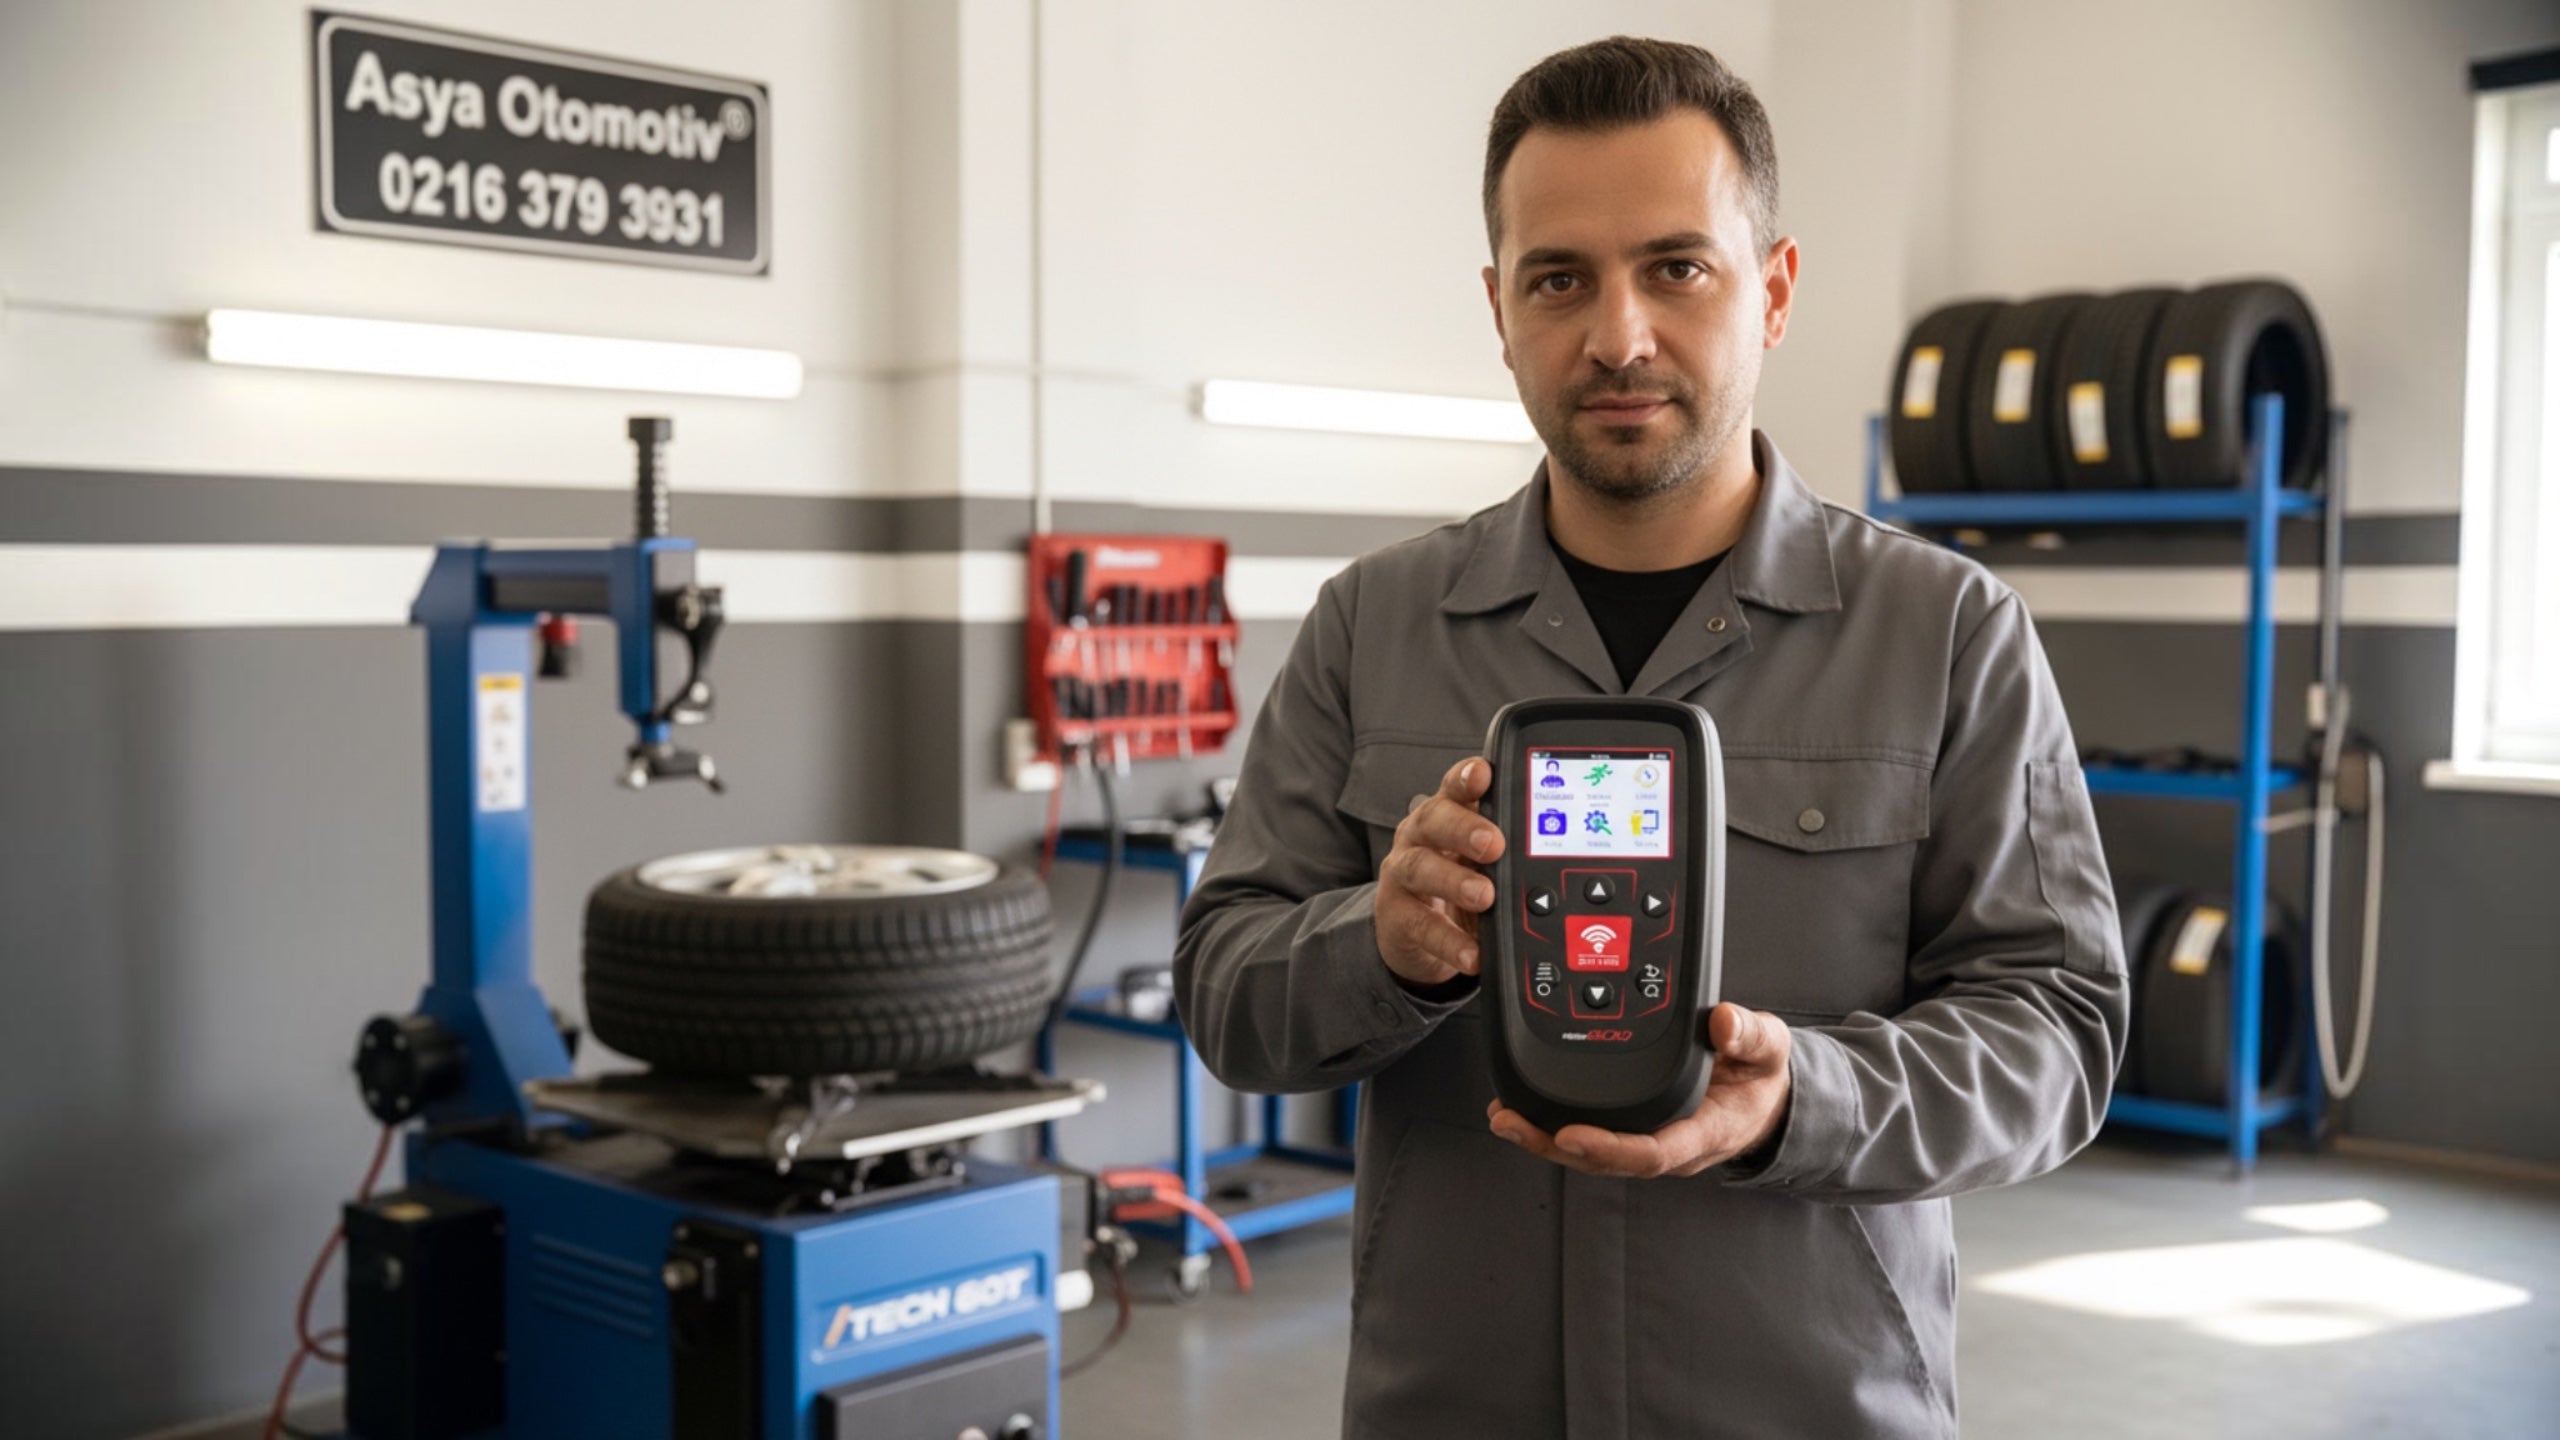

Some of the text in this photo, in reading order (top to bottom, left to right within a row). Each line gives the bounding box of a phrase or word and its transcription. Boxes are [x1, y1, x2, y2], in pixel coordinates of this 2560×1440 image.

[345, 51, 485, 137] Asya
[379, 152, 724, 247] 0216 379 3931
